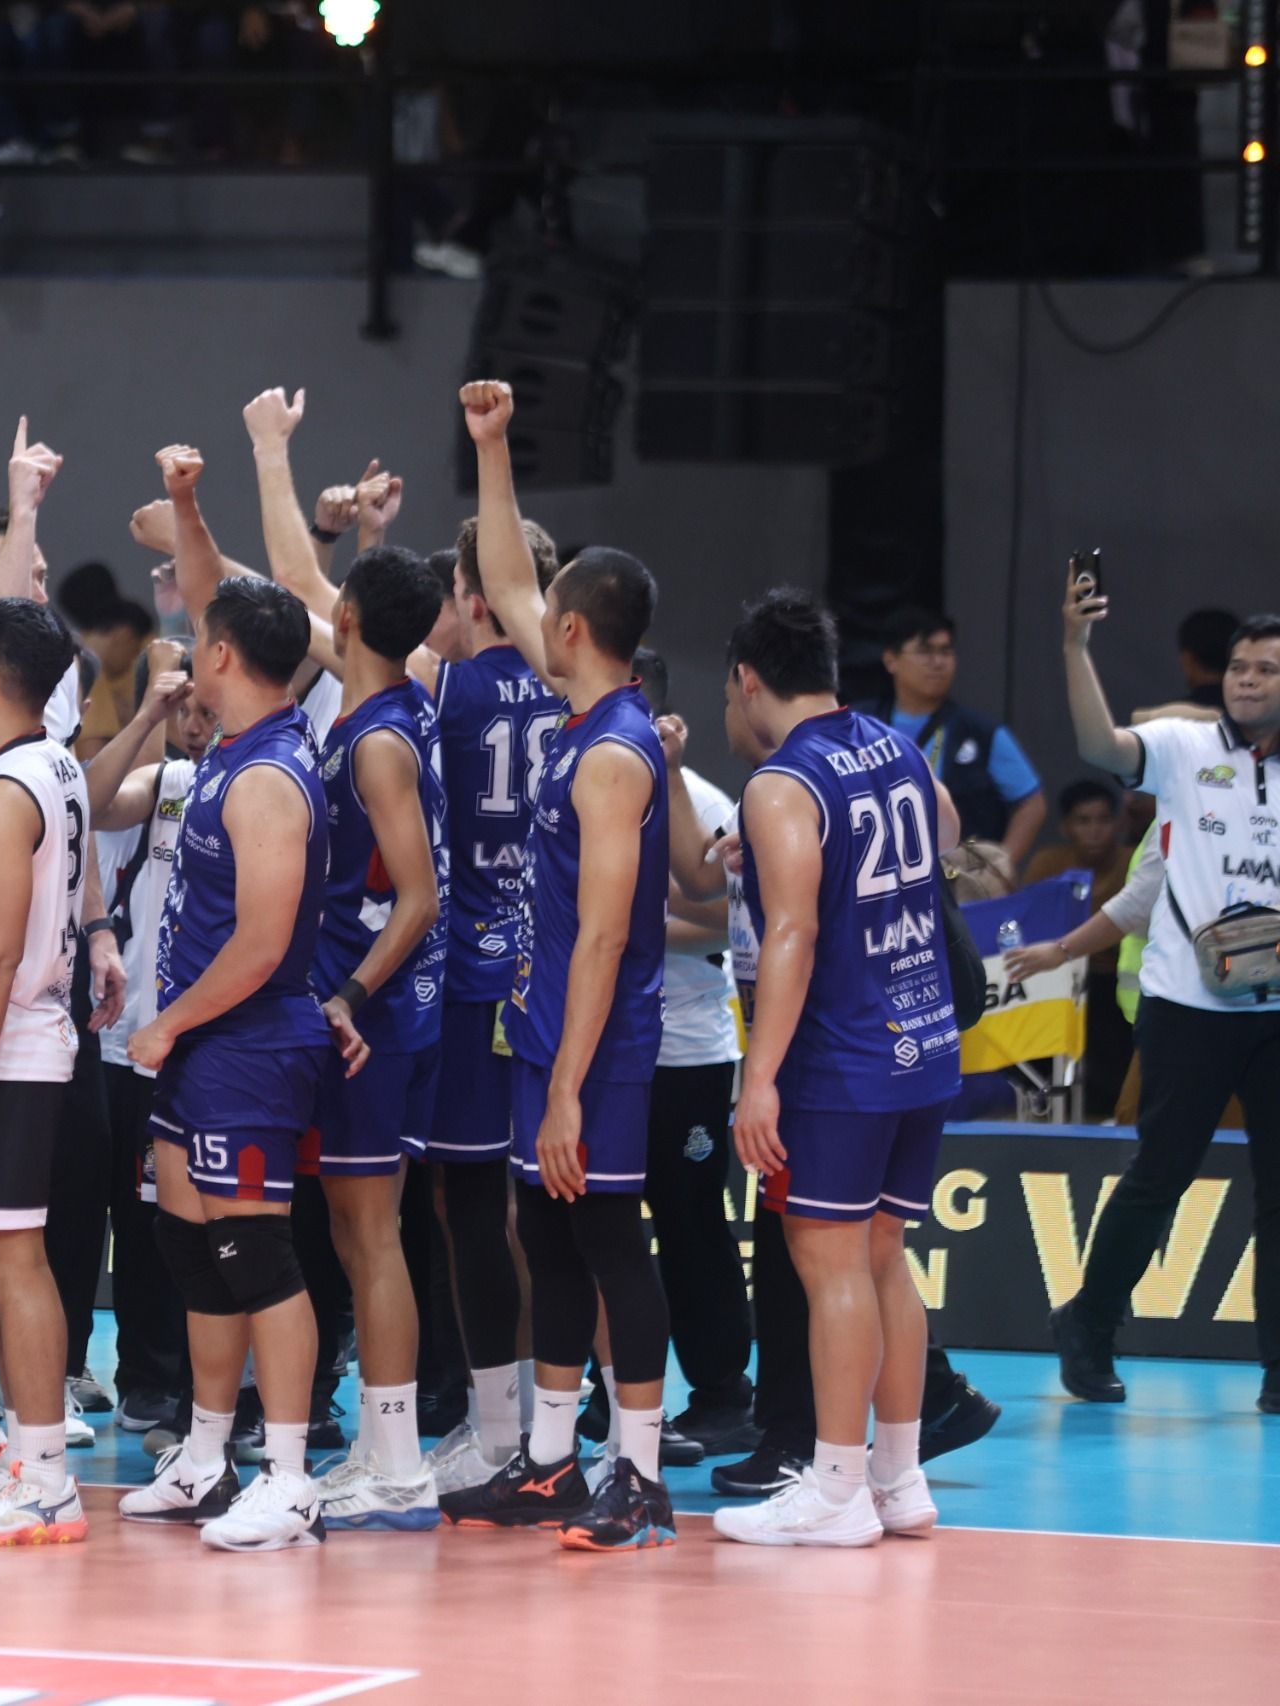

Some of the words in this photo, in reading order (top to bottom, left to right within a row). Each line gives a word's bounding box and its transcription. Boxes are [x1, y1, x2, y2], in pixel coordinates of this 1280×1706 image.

[848, 776, 933, 904] 20
[192, 1133, 228, 1170] 15
[380, 1400, 405, 1415] 23
